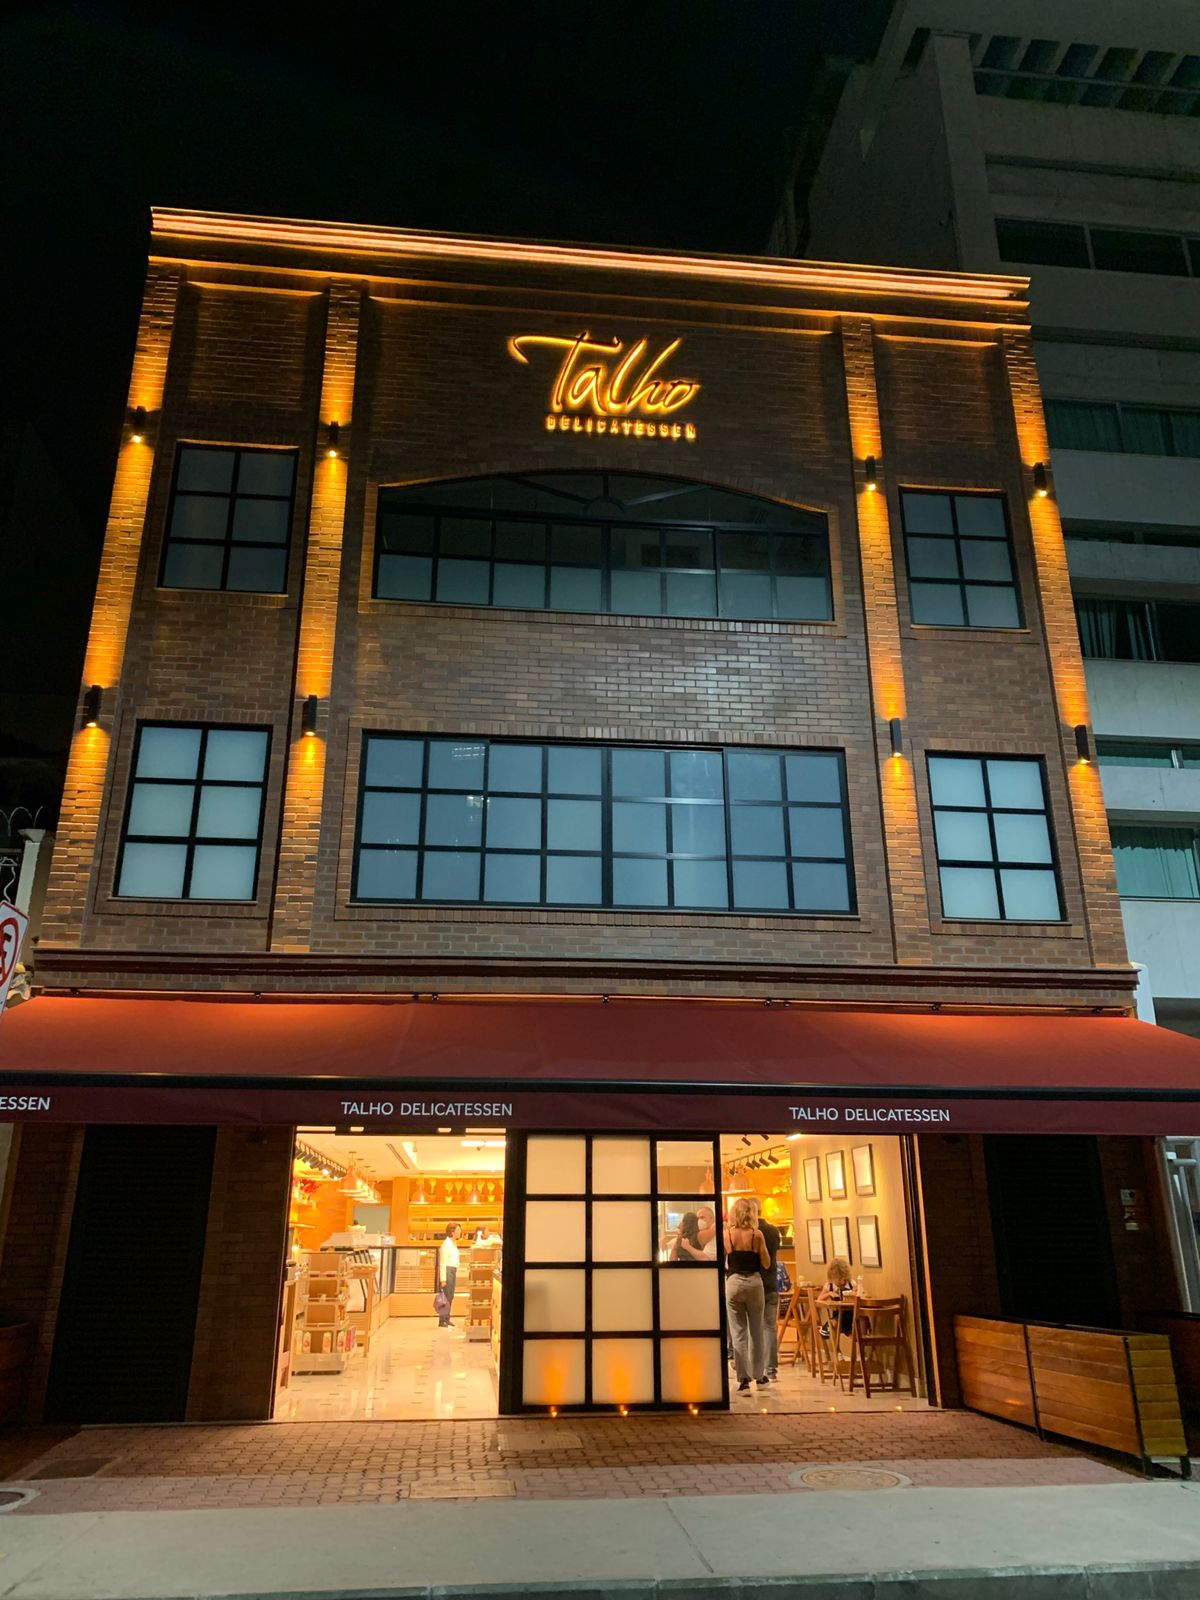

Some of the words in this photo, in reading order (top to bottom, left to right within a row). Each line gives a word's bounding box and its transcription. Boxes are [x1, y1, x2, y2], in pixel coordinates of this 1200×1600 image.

[545, 414, 697, 441] DELICATESSEN
[341, 1101, 394, 1116] TALHO
[400, 1102, 513, 1117] DELICATESSEN
[789, 1106, 839, 1122] TALHO
[845, 1107, 951, 1123] DELICATESSEN
